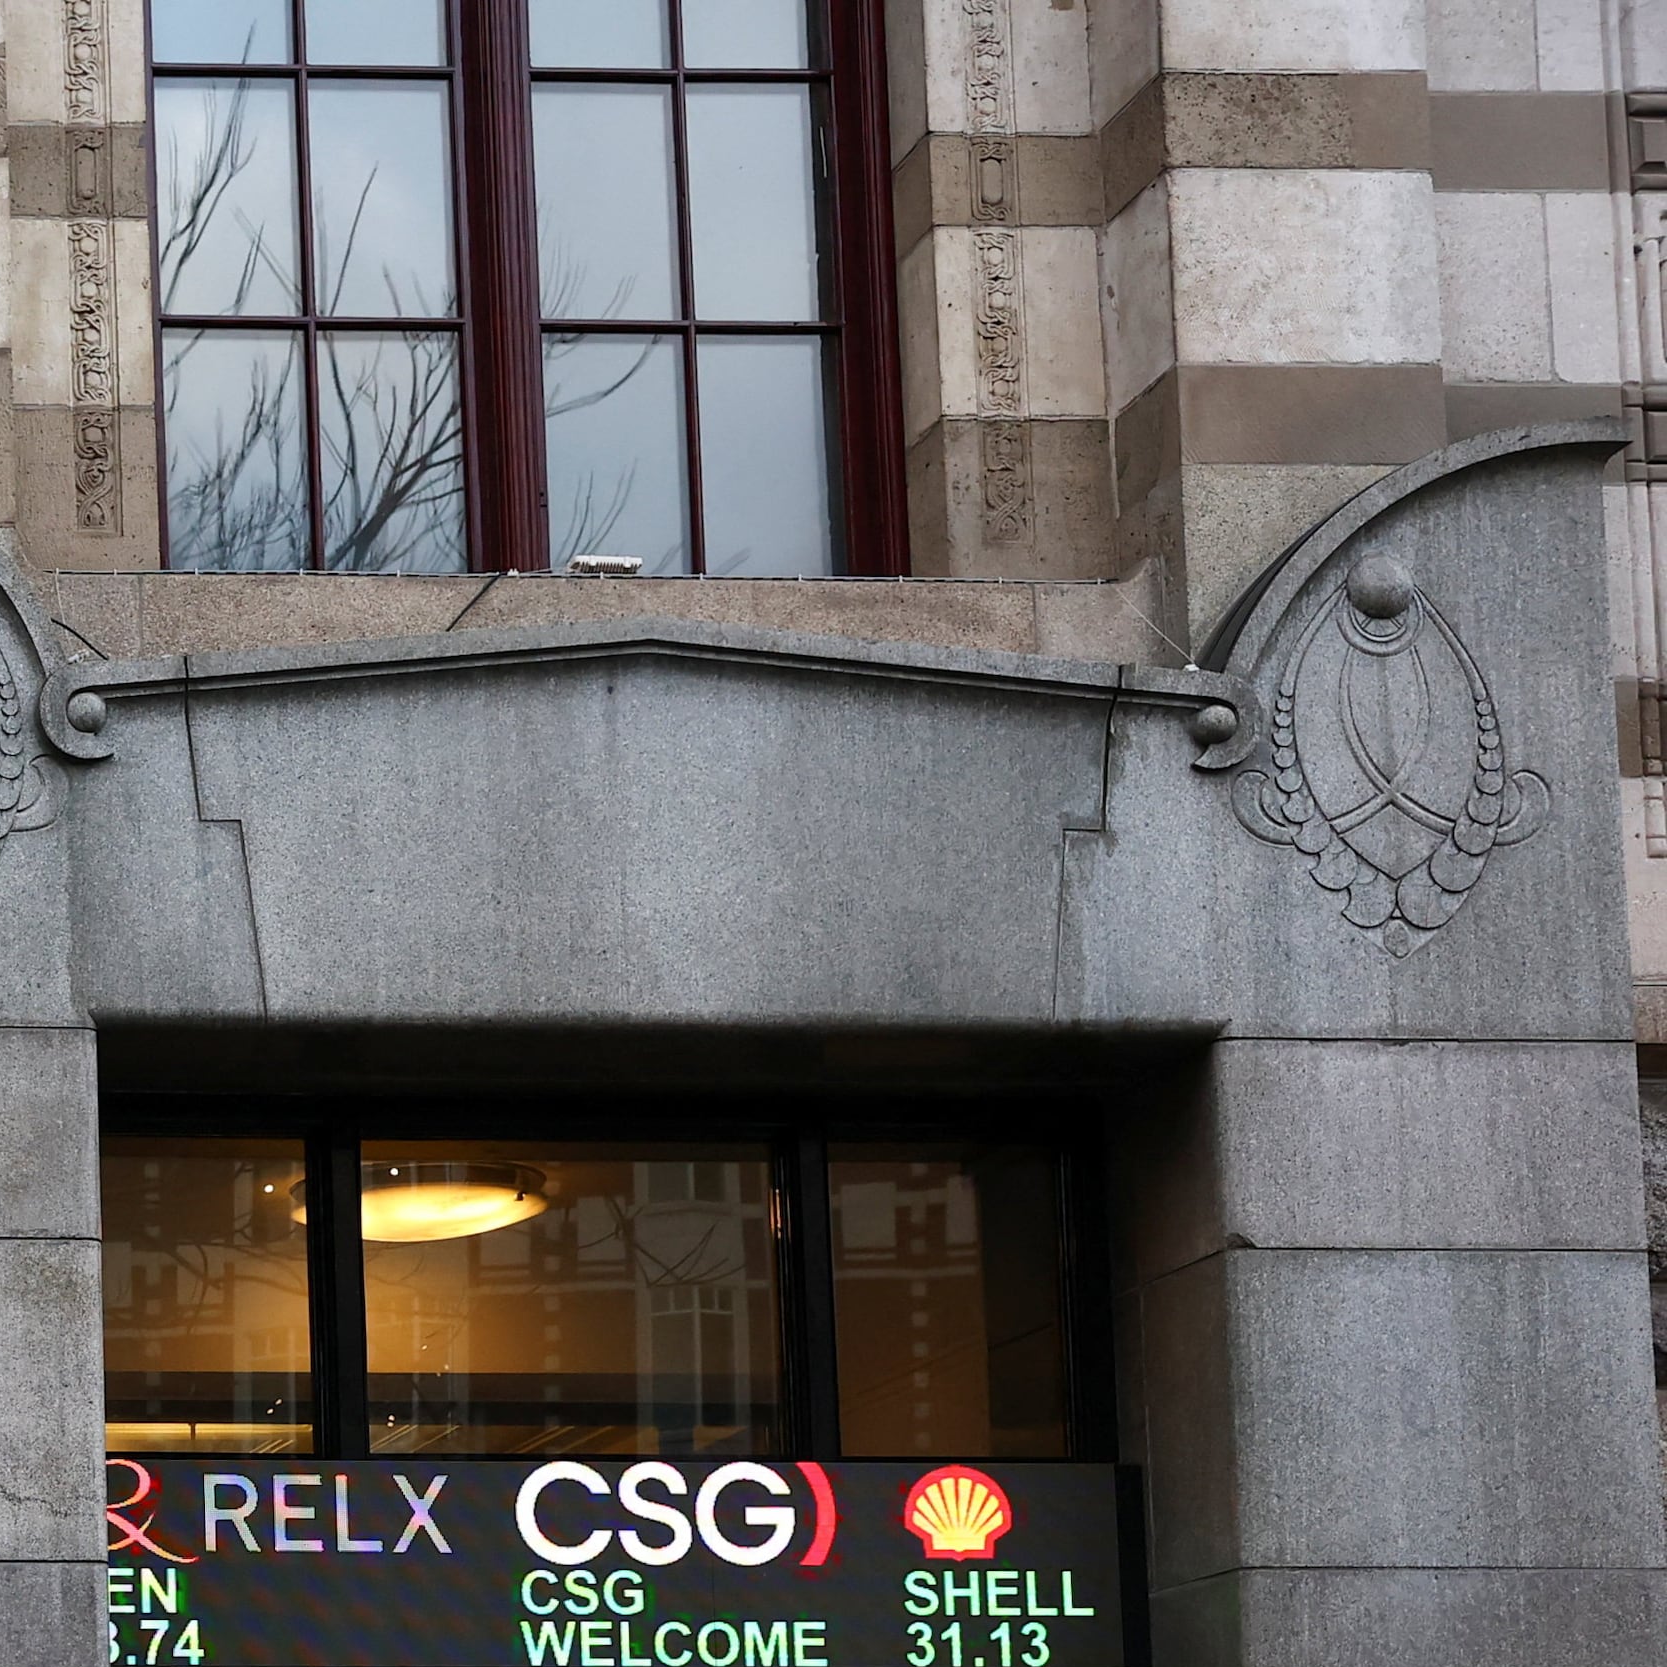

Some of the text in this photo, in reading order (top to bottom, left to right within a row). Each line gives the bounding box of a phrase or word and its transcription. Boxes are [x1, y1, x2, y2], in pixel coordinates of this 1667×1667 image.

[203, 1473, 453, 1553] RELX
[520, 1570, 645, 1616] CSG
[903, 1570, 1095, 1616] SHELL
[519, 1621, 829, 1667] WELCOME
[906, 1621, 1050, 1667] 31.13
